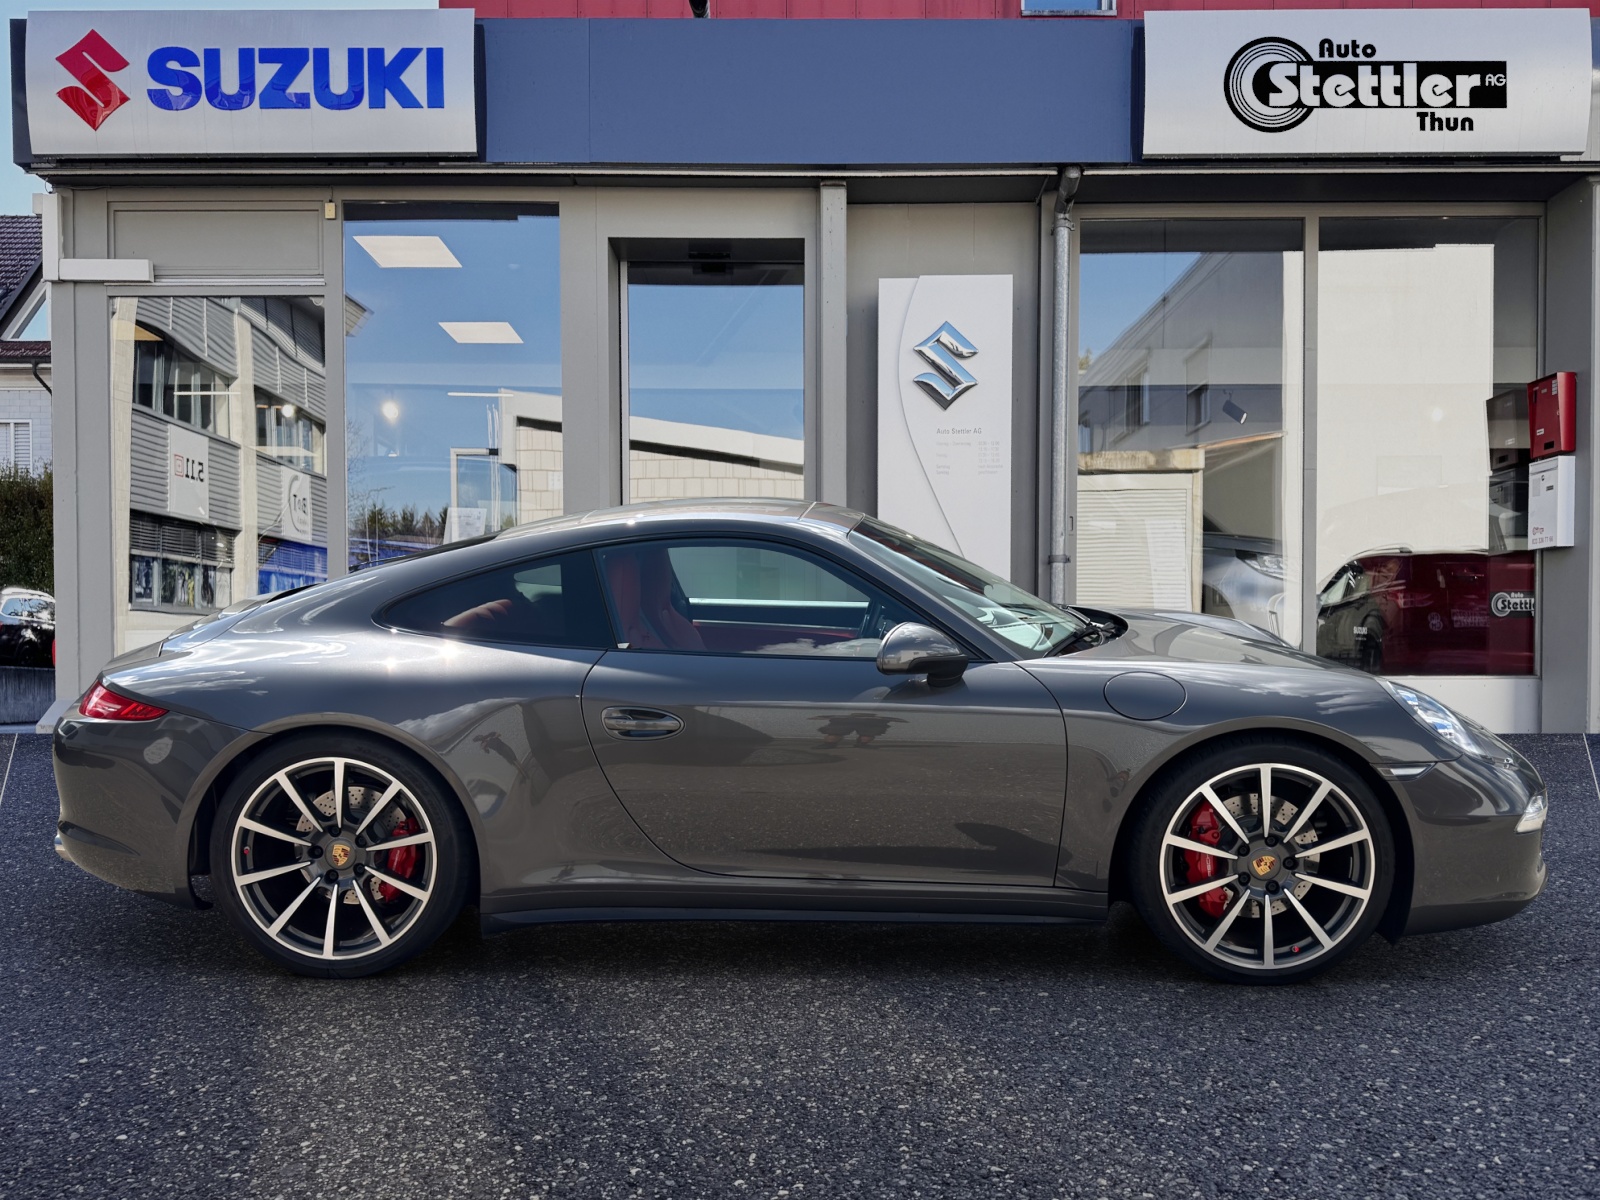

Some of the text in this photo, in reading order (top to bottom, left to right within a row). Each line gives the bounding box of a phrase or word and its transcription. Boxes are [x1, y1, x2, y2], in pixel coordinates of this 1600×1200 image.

[1319, 38, 1377, 58] Auto
[147, 46, 445, 111] SUZUKI
[1268, 62, 1507, 107] Stettler AG
[1416, 112, 1474, 131] Thun
[936, 427, 982, 435] Auto Stettler AG
